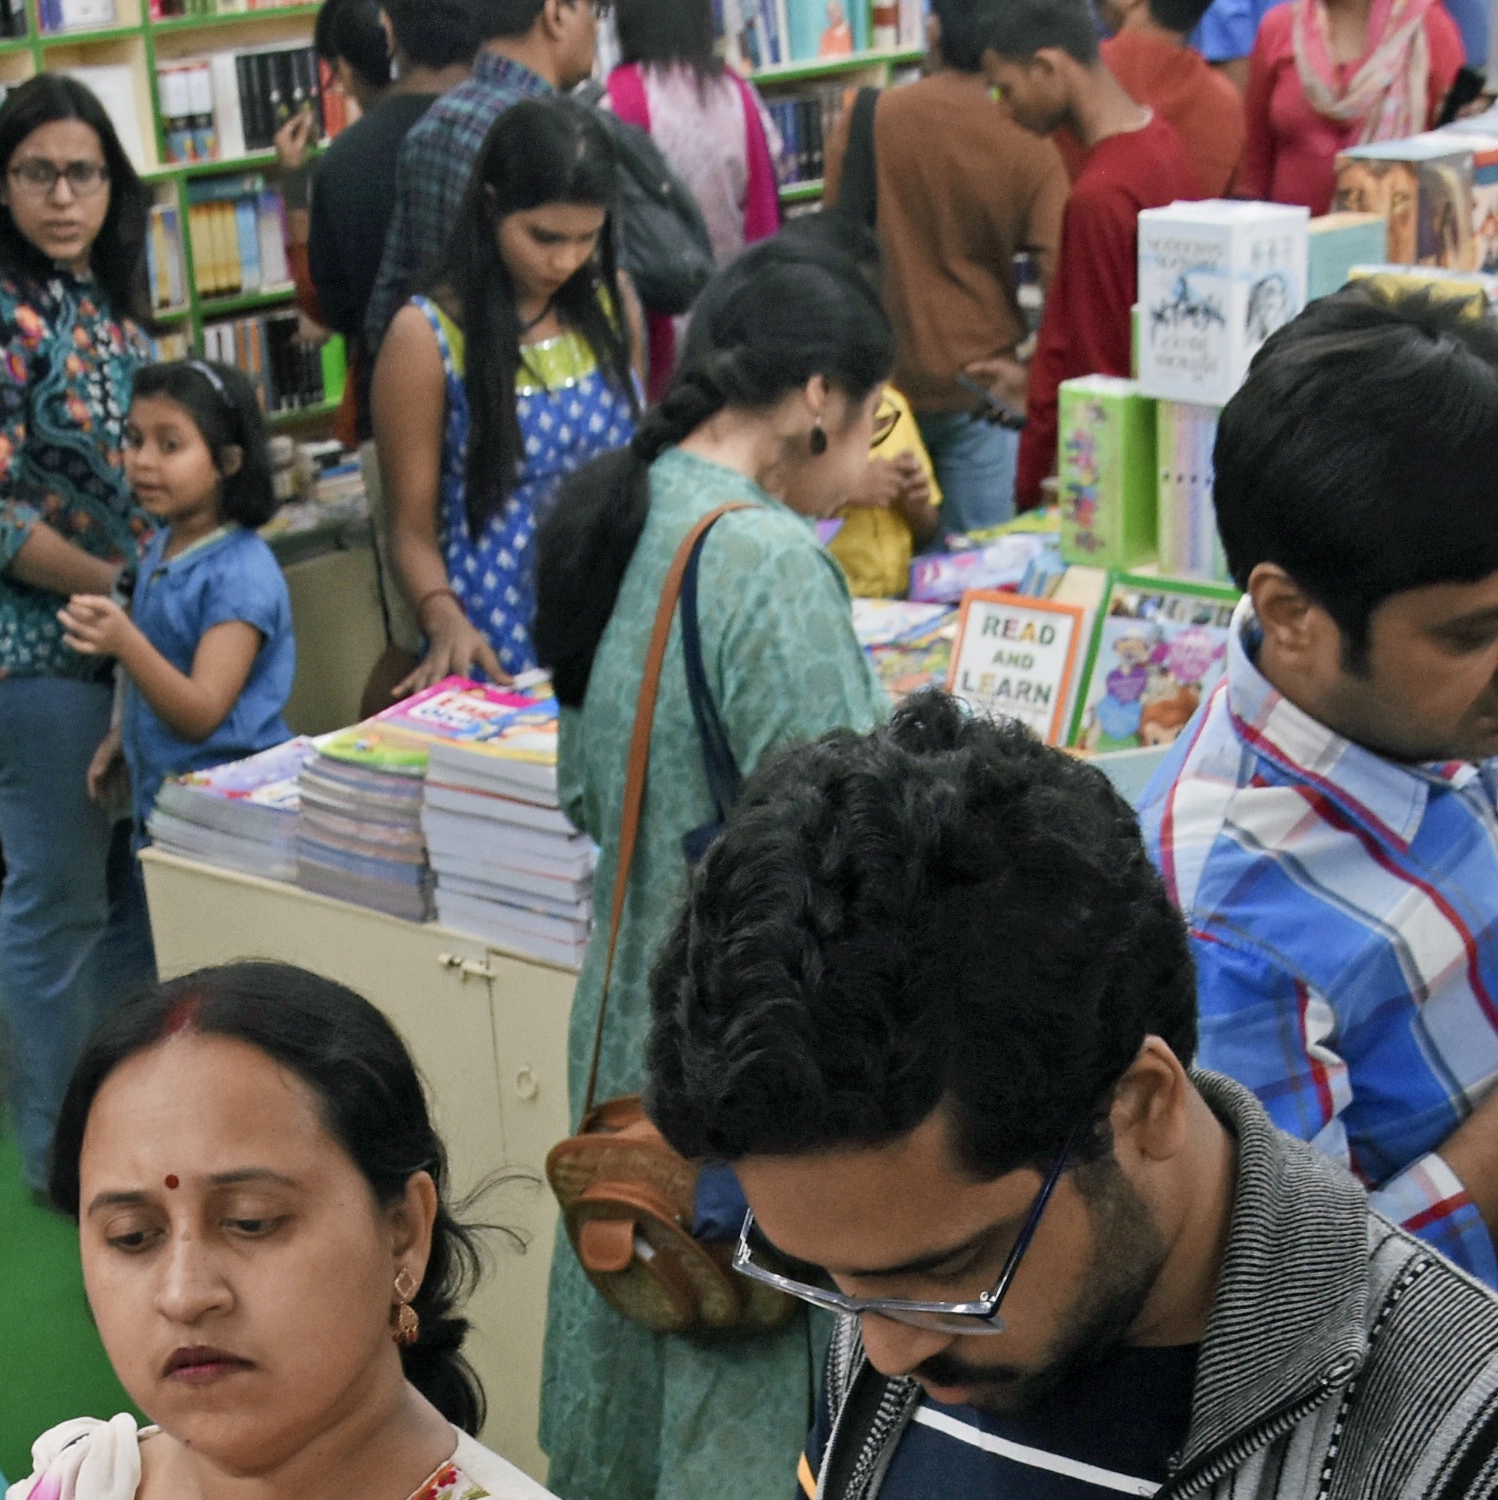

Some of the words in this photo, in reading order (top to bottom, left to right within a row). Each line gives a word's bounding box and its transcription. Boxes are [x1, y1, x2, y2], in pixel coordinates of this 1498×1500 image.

[981, 613, 1055, 647] READ
[992, 649, 1034, 671] AND
[961, 672, 1054, 706] LEARN
